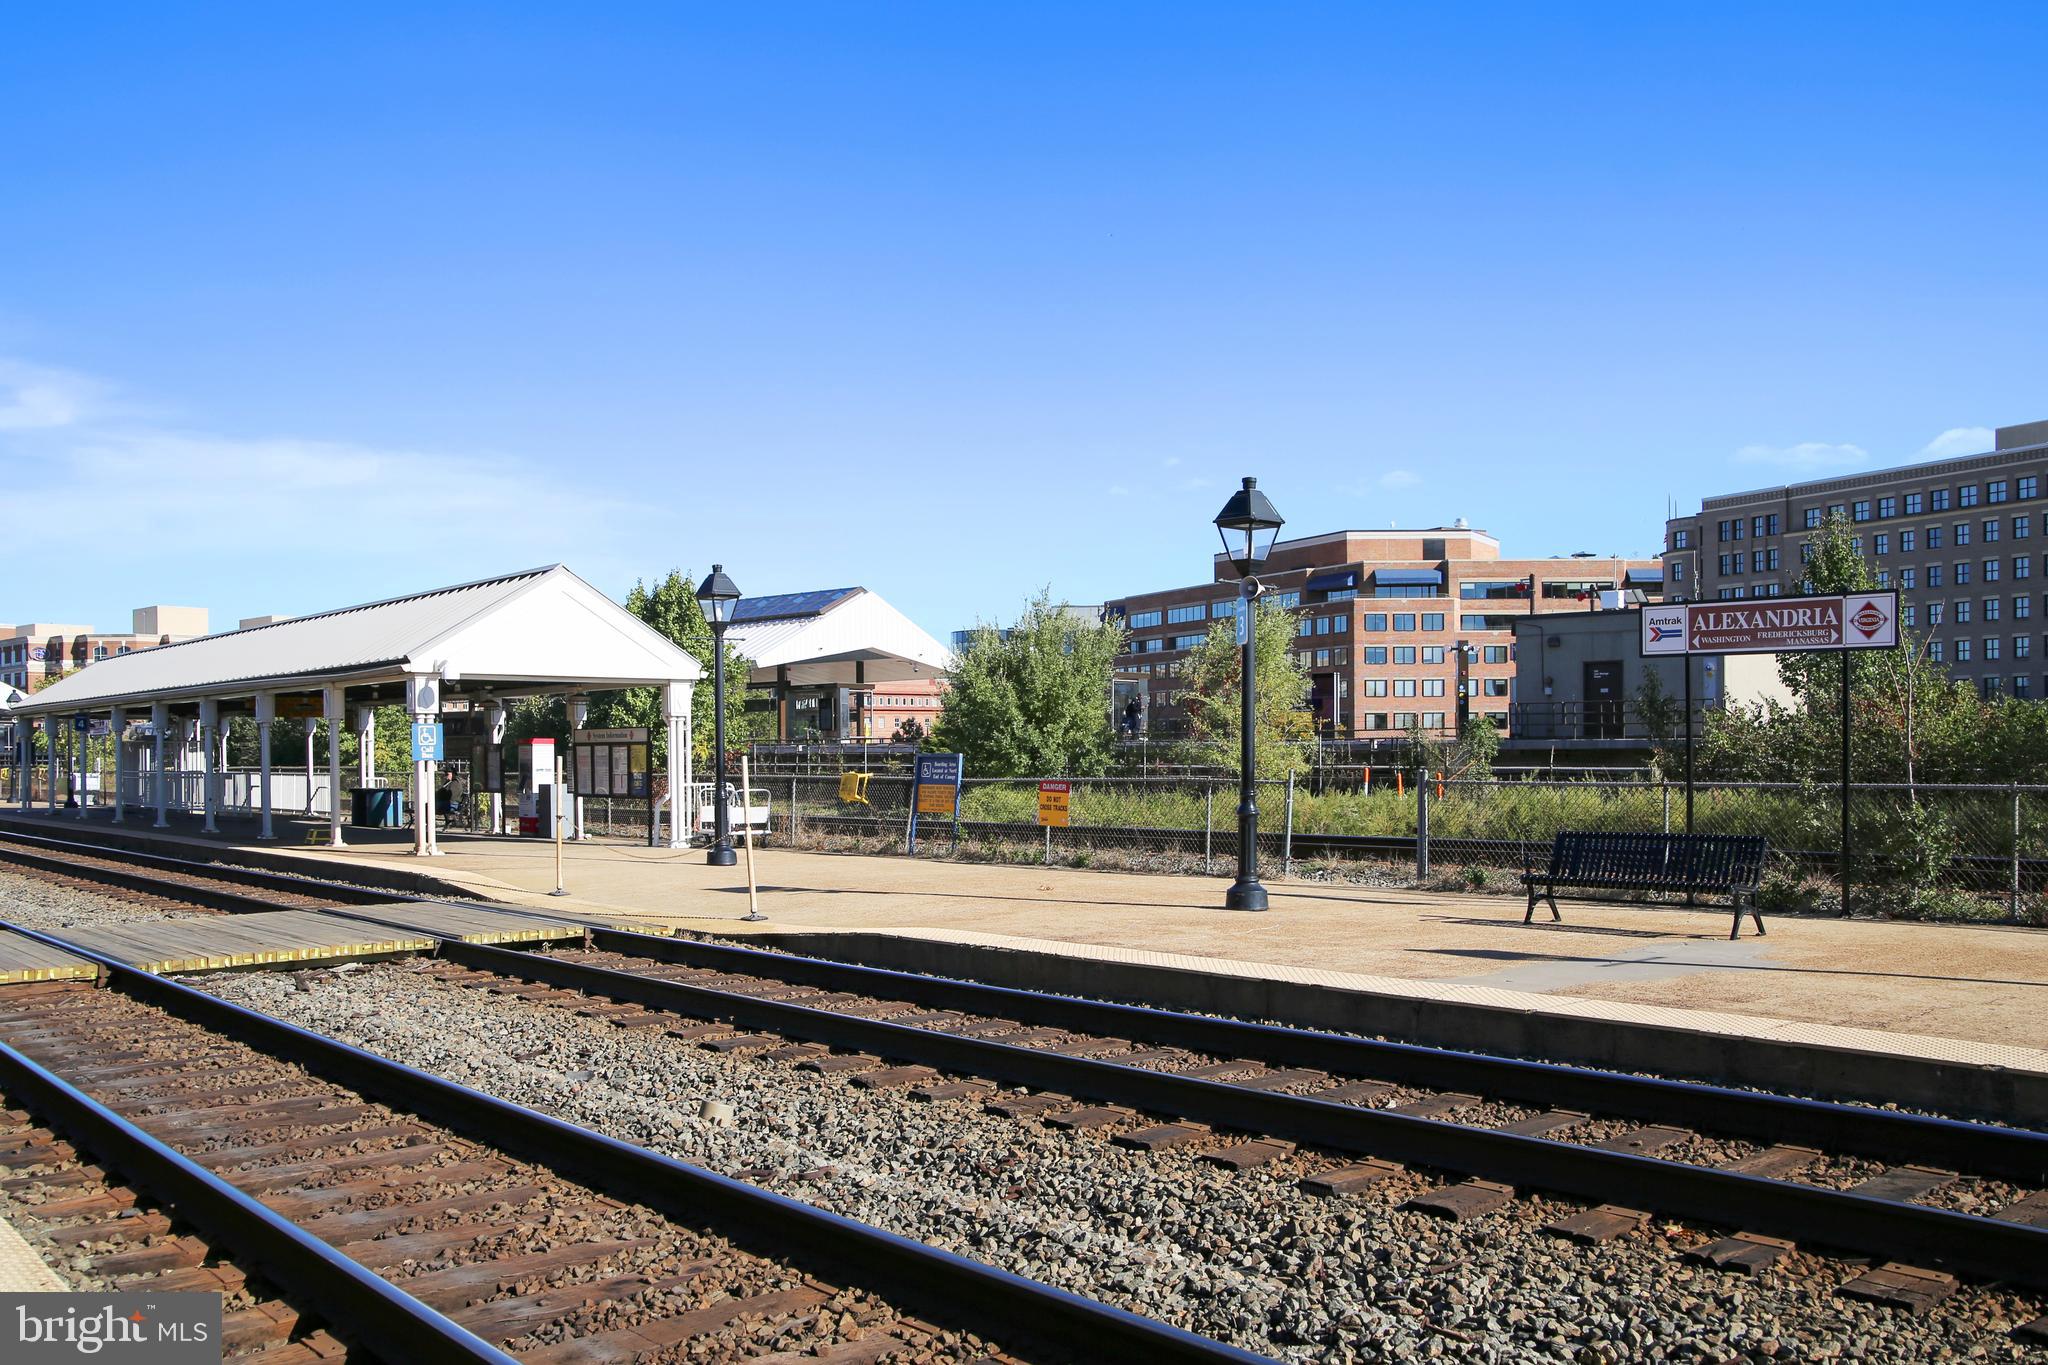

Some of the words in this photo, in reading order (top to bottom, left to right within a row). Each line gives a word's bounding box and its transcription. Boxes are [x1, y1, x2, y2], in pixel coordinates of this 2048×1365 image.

[1649, 616, 1682, 625] Amtrak
[1693, 607, 1839, 631] ALEXANDRIA
[1239, 616, 1244, 636] 3
[1757, 629, 1829, 639] FREDERICKSBURG
[1701, 635, 1751, 644] WASHINGTON
[1786, 637, 1829, 645] MANASSAS
[1043, 783, 1067, 791] DANGER
